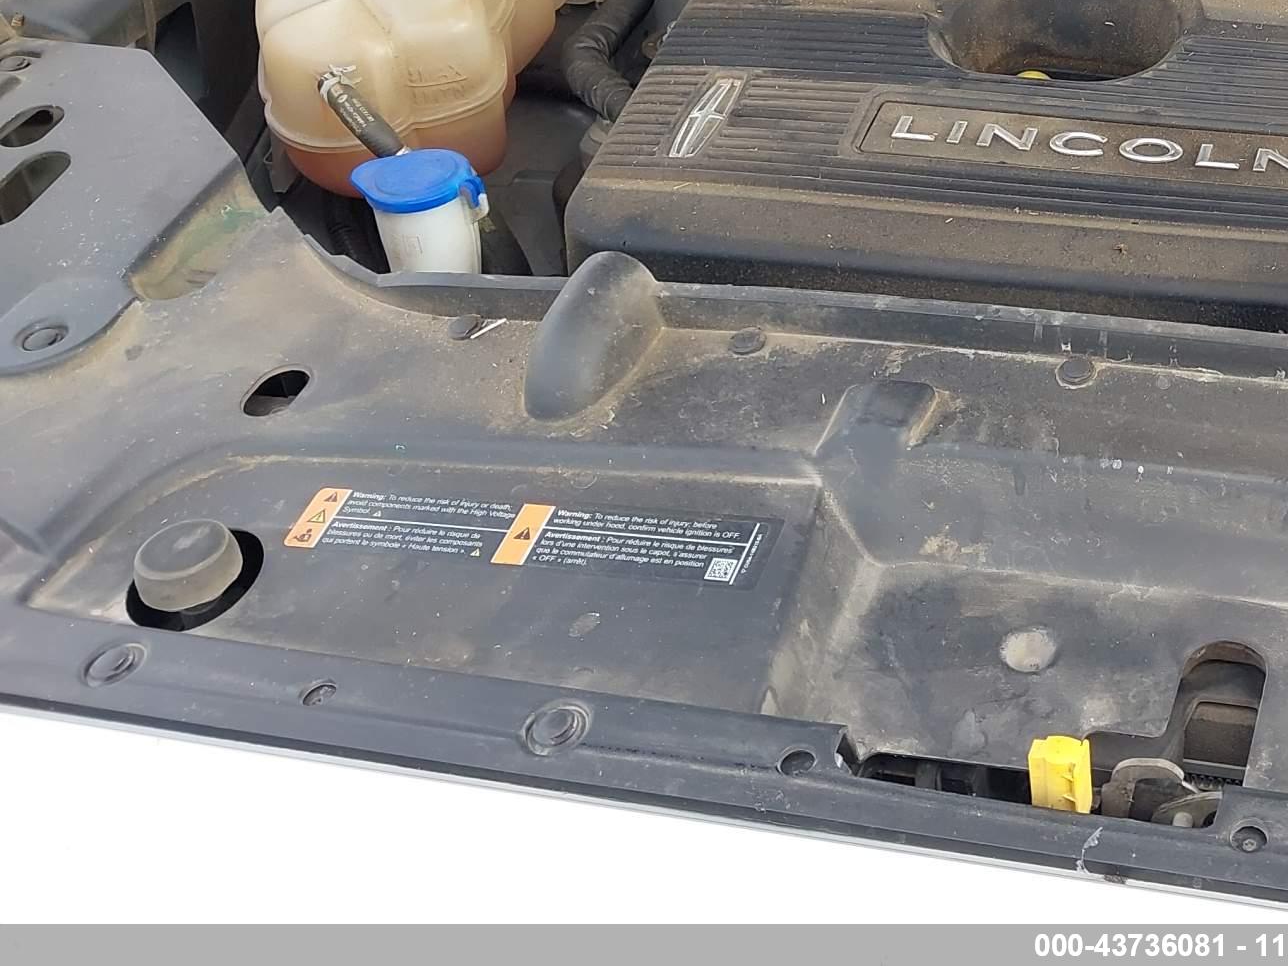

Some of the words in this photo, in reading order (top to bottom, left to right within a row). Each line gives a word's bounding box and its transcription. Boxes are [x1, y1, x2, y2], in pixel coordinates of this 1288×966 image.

[353, 492, 387, 500] Warning:
[460, 498, 480, 509] injury
[368, 502, 412, 510] components
[490, 510, 516, 520] Voltage
[558, 510, 592, 520] Warning:
[594, 512, 603, 520] To
[692, 521, 718, 529] before
[332, 521, 388, 531] Avertissement
[554, 518, 582, 526] working
[605, 522, 626, 530] hood,
[628, 524, 657, 532] confirm
[326, 529, 362, 537] blessures
[438, 538, 482, 548] composants
[540, 538, 555, 546] lors
[556, 540, 576, 548] d'une
[576, 543, 620, 552] intervention
[544, 532, 600, 542] Avertissement
[606, 536, 625, 544] Pour
[624, 538, 652, 546] réduire
[660, 542, 684, 550] risque
[432, 546, 459, 554] tension
[560, 550, 608, 559] commutateur
[608, 554, 650, 564] d'allumage
[674, 560, 705, 568] position
